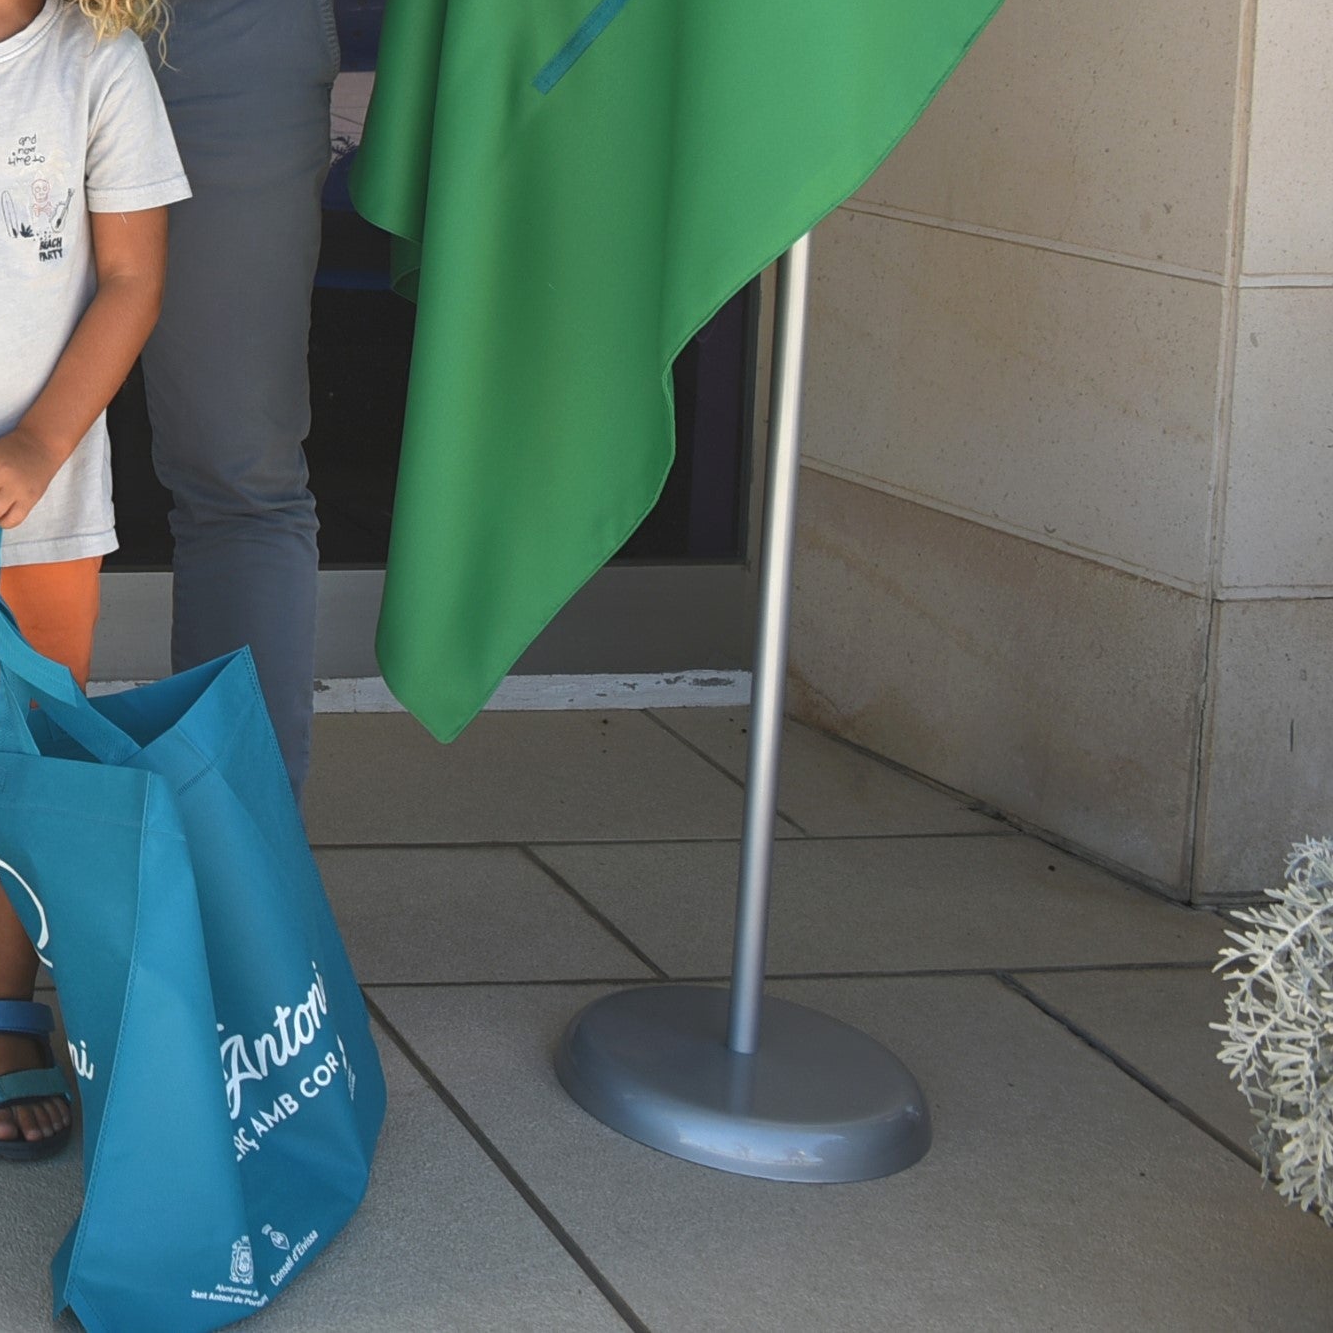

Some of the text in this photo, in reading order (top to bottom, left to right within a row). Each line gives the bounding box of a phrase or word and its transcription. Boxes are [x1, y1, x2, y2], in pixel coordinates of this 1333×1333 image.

[18, 133, 37, 145] and
[17, 146, 36, 155] now
[8, 152, 31, 165] time
[39, 237, 63, 250] BEACH
[39, 249, 63, 262] PARTY
[250, 1093, 299, 1138] AMB
[300, 1052, 339, 1098] COR
[270, 1255, 295, 1286] Consell
[191, 1289, 208, 1300] Sant
[208, 1292, 233, 1303] Antoni
